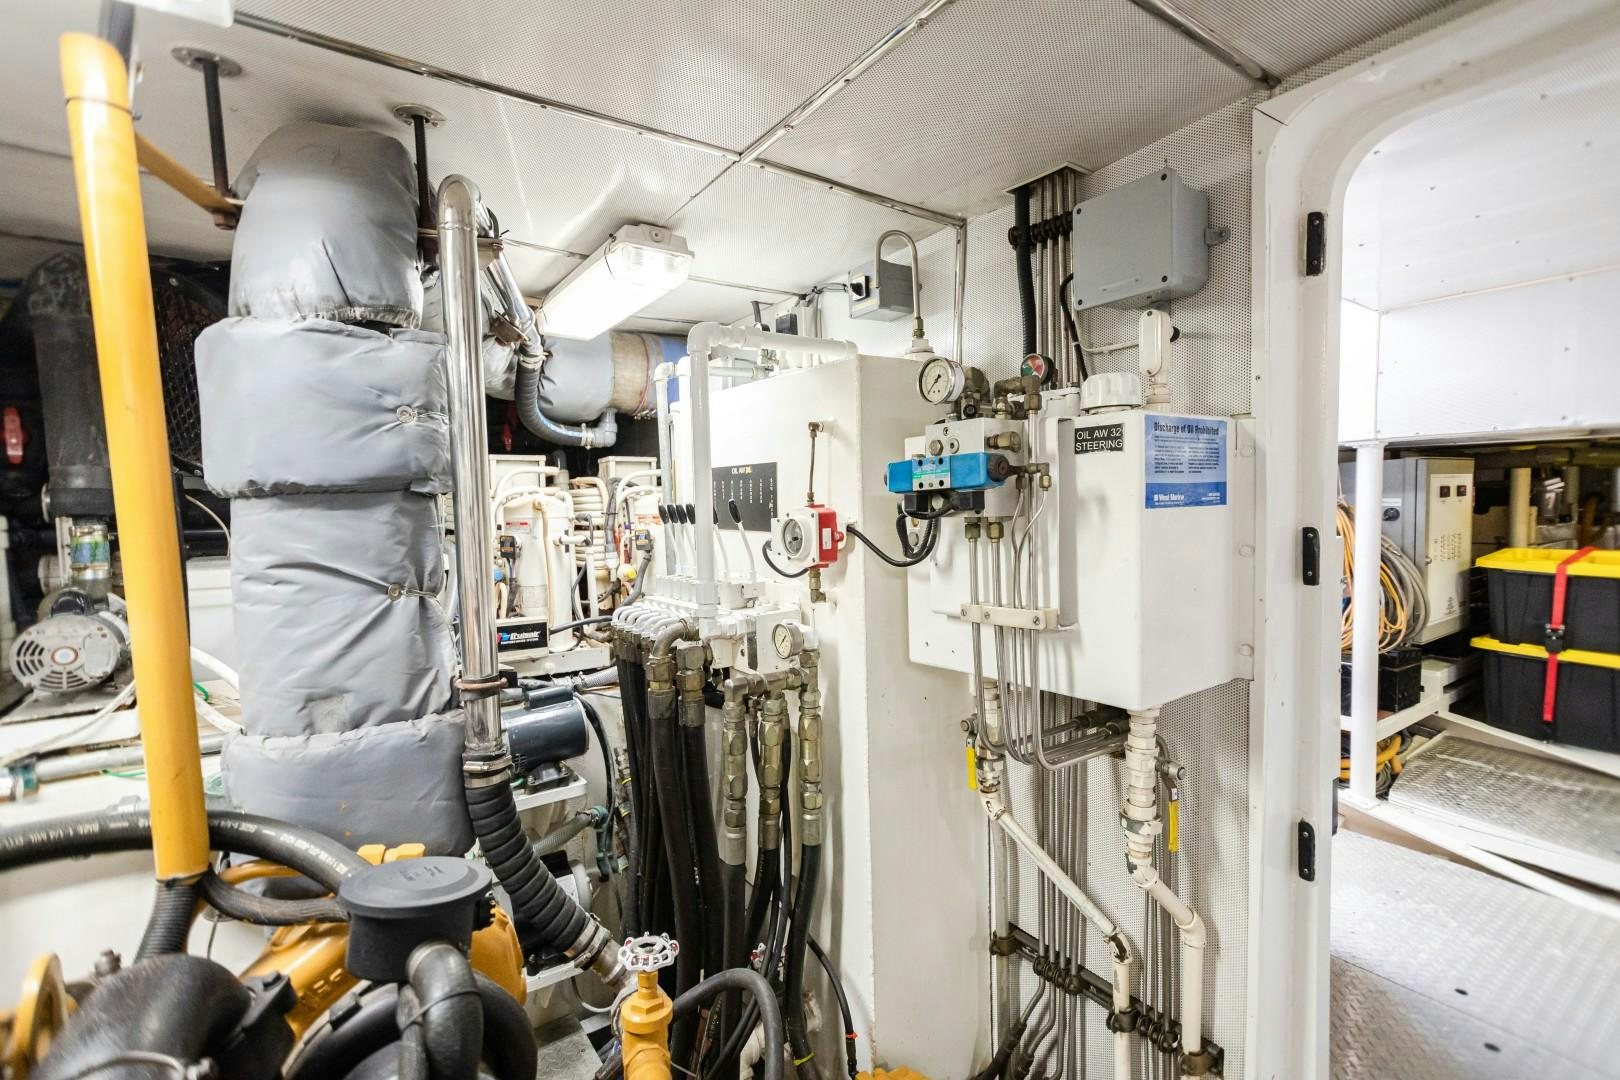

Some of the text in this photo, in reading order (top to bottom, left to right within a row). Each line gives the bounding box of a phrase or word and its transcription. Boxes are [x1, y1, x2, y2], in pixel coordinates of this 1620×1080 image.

[1076, 427, 1122, 440] OIL AW 32
[1154, 421, 1179, 434] Discharge
[1180, 423, 1186, 433] of
[1195, 424, 1219, 435] Prohibited
[1075, 438, 1123, 451] STEERING
